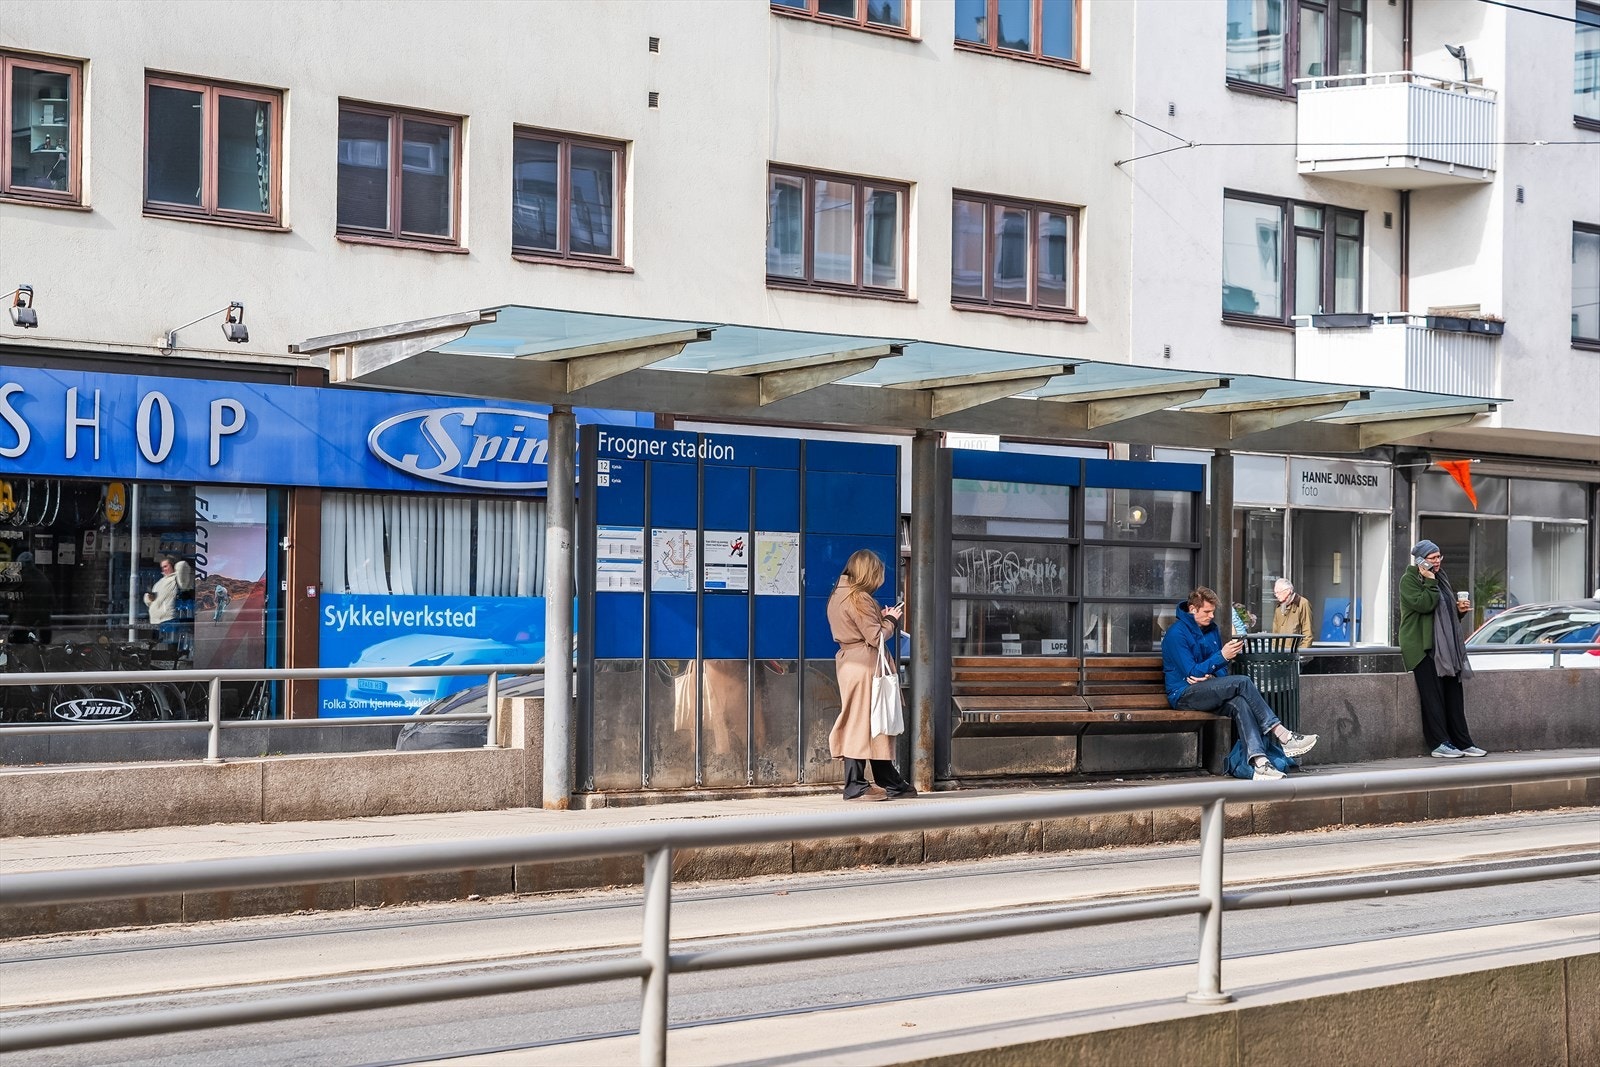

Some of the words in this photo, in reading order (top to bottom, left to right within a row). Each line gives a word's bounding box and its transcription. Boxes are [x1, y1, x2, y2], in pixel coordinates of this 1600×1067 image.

[0, 383, 246, 466] SHOP
[401, 408, 580, 475] Spin
[597, 431, 667, 459] Frogner
[671, 438, 735, 461] stadion
[1302, 471, 1333, 484] HANNE
[1334, 473, 1378, 487] JONASSEN
[1302, 483, 1319, 497] foto
[195, 496, 209, 581] FACTOR
[324, 604, 476, 632] Sykkelverksted
[63, 699, 122, 719] Spinn
[323, 699, 347, 709] Folka
[349, 701, 367, 709] som
[370, 697, 402, 711] kjenner
